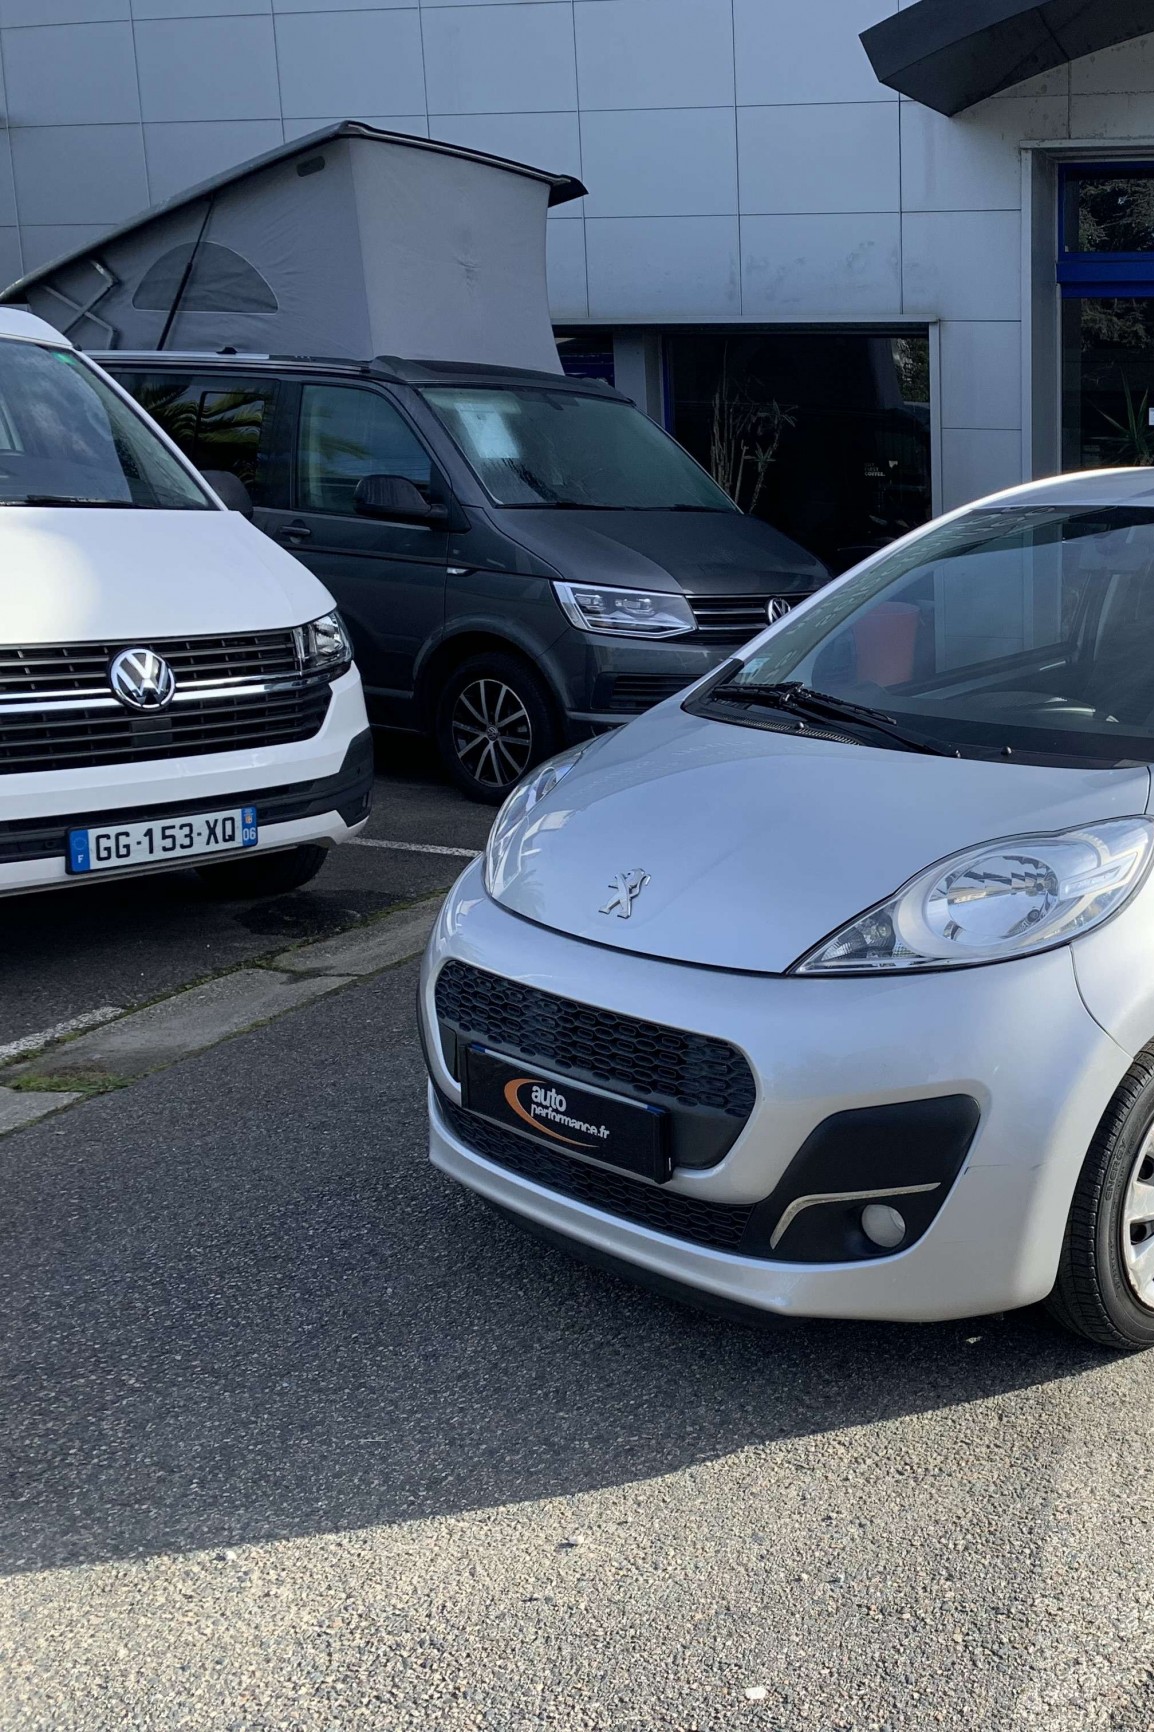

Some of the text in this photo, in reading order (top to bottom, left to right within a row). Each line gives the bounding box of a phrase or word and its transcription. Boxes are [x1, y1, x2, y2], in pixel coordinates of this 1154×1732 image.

[77, 854, 84, 863] F
[242, 828, 256, 841] 06
[531, 1085, 567, 1113] auto
[530, 1103, 610, 1139] performance.fr
[1104, 1137, 1127, 1202] ENERGY
